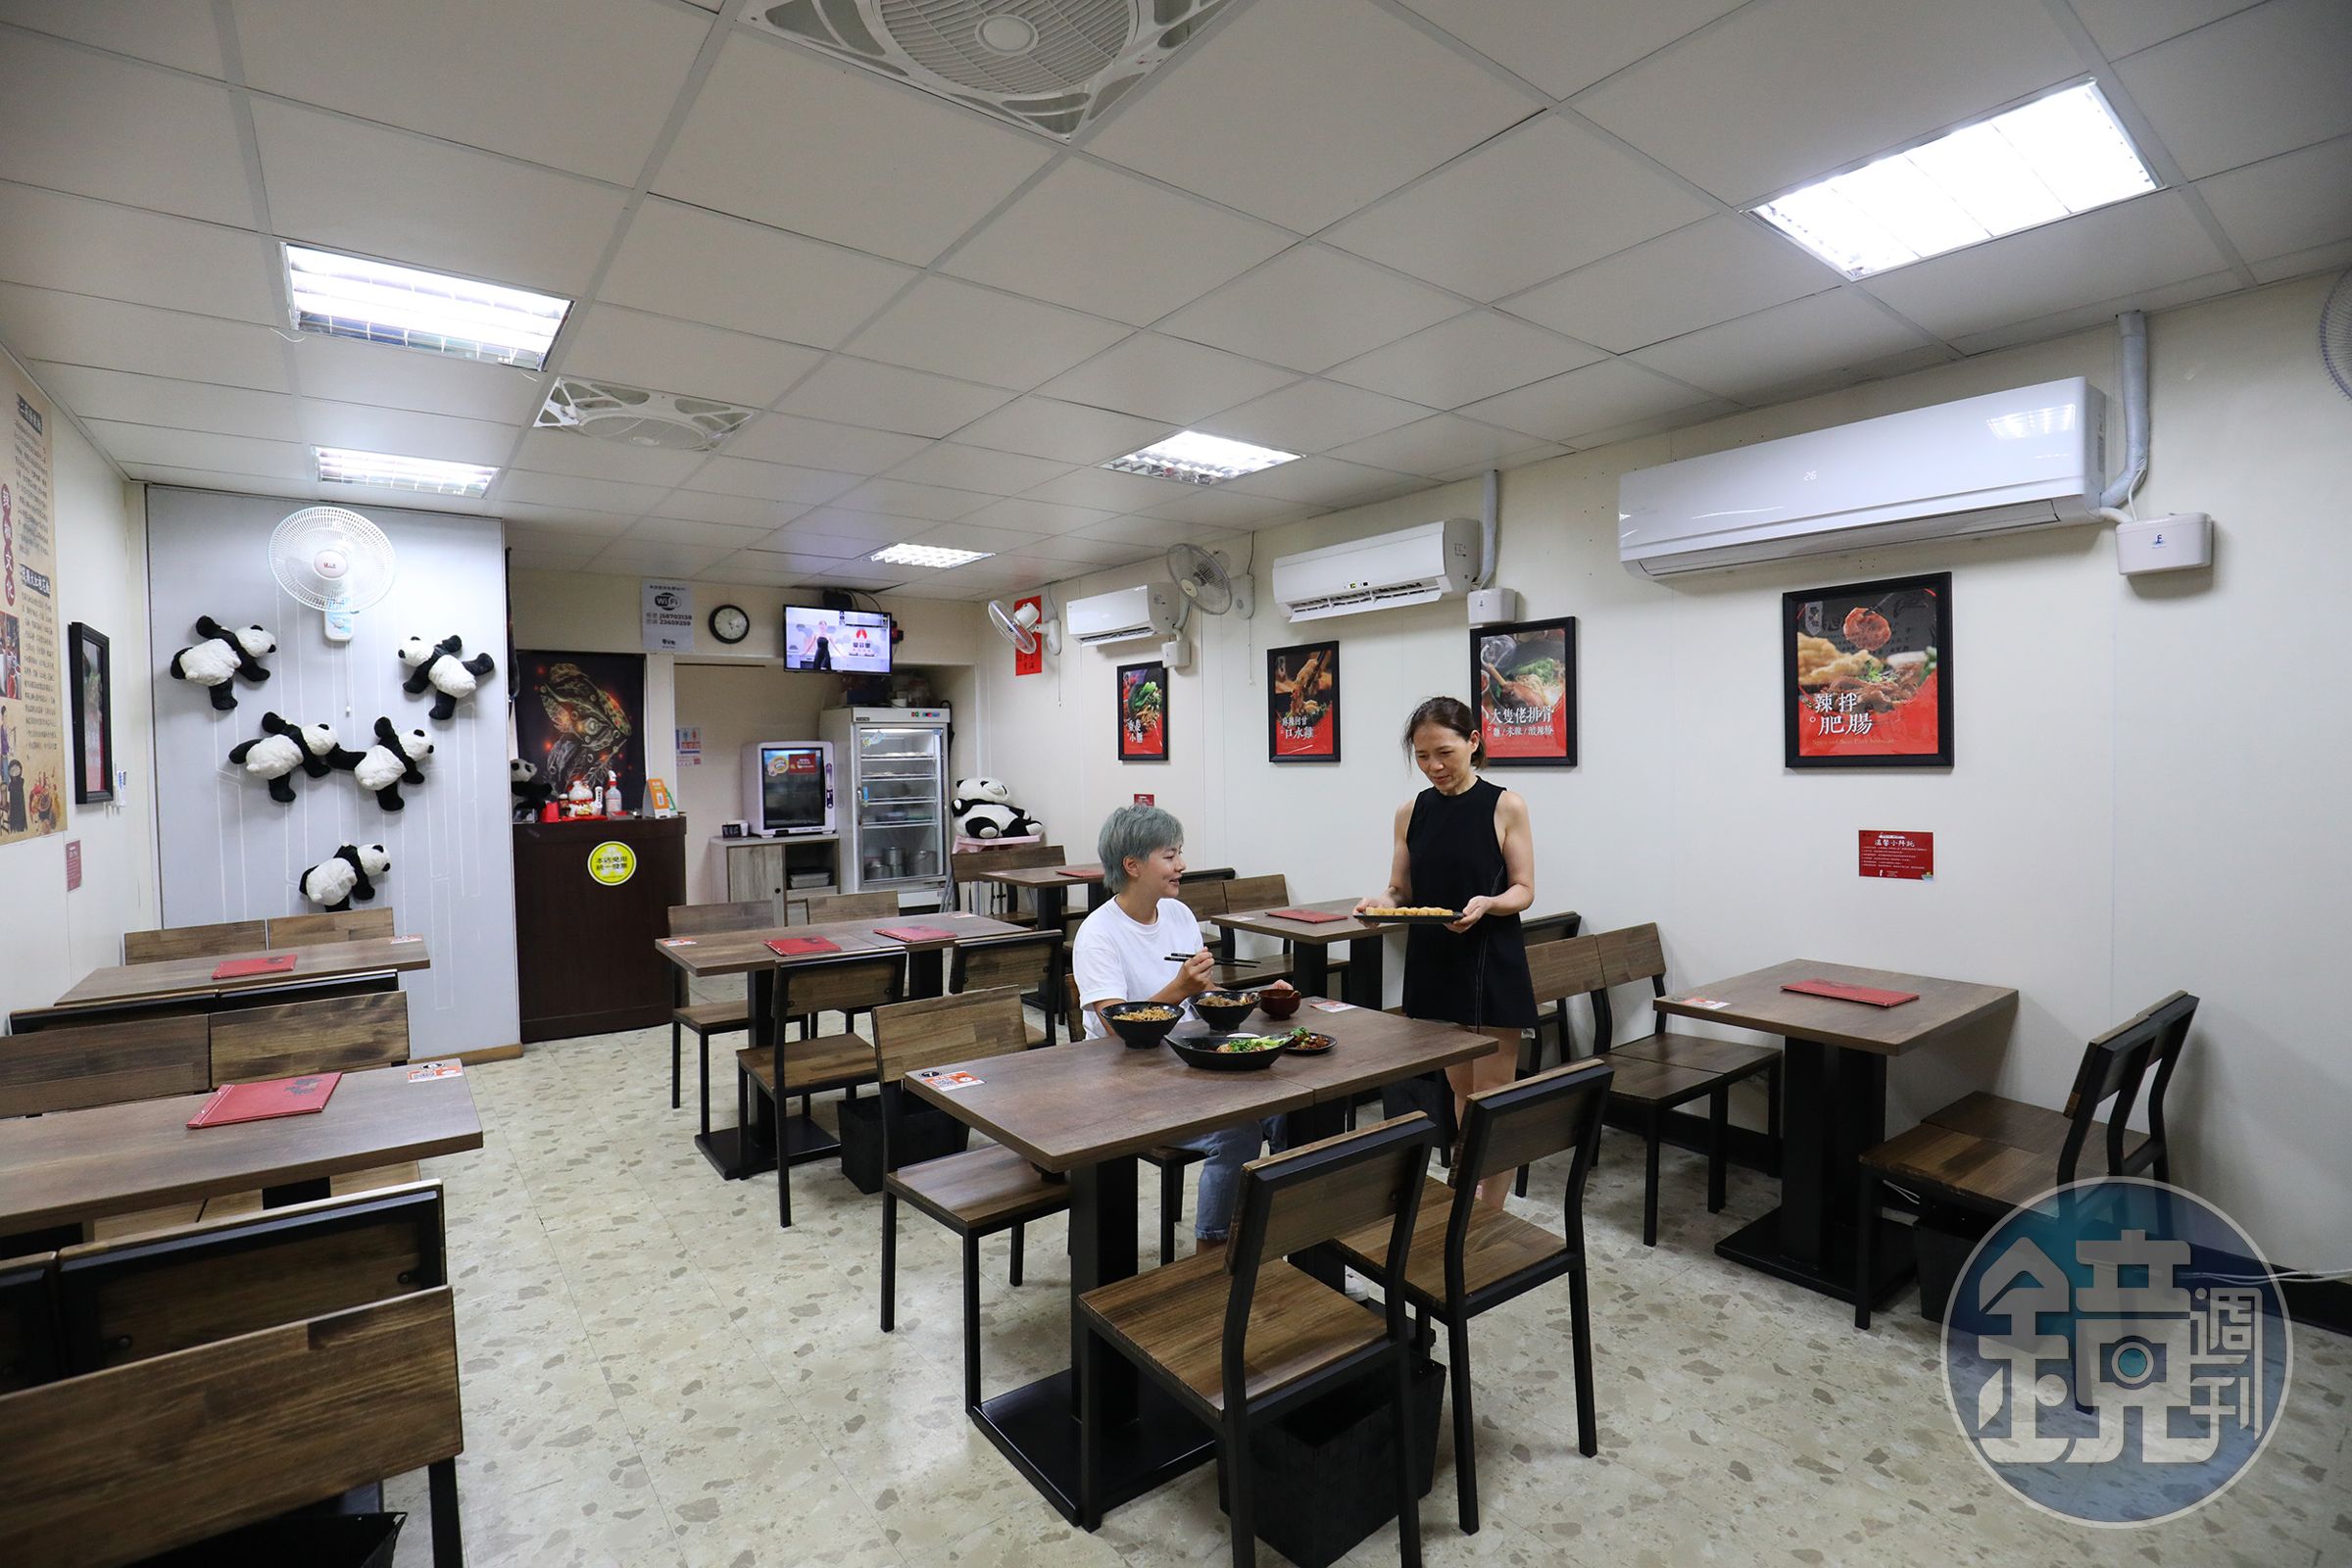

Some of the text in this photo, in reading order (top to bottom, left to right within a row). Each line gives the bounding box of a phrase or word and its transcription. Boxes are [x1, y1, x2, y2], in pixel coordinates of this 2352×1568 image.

[1815, 692, 1857, 713] 辣拌
[1490, 706, 1551, 725] 大隻佬排骨
[1818, 712, 1873, 736] 肥腸
[1285, 726, 1314, 740] 口水雞
